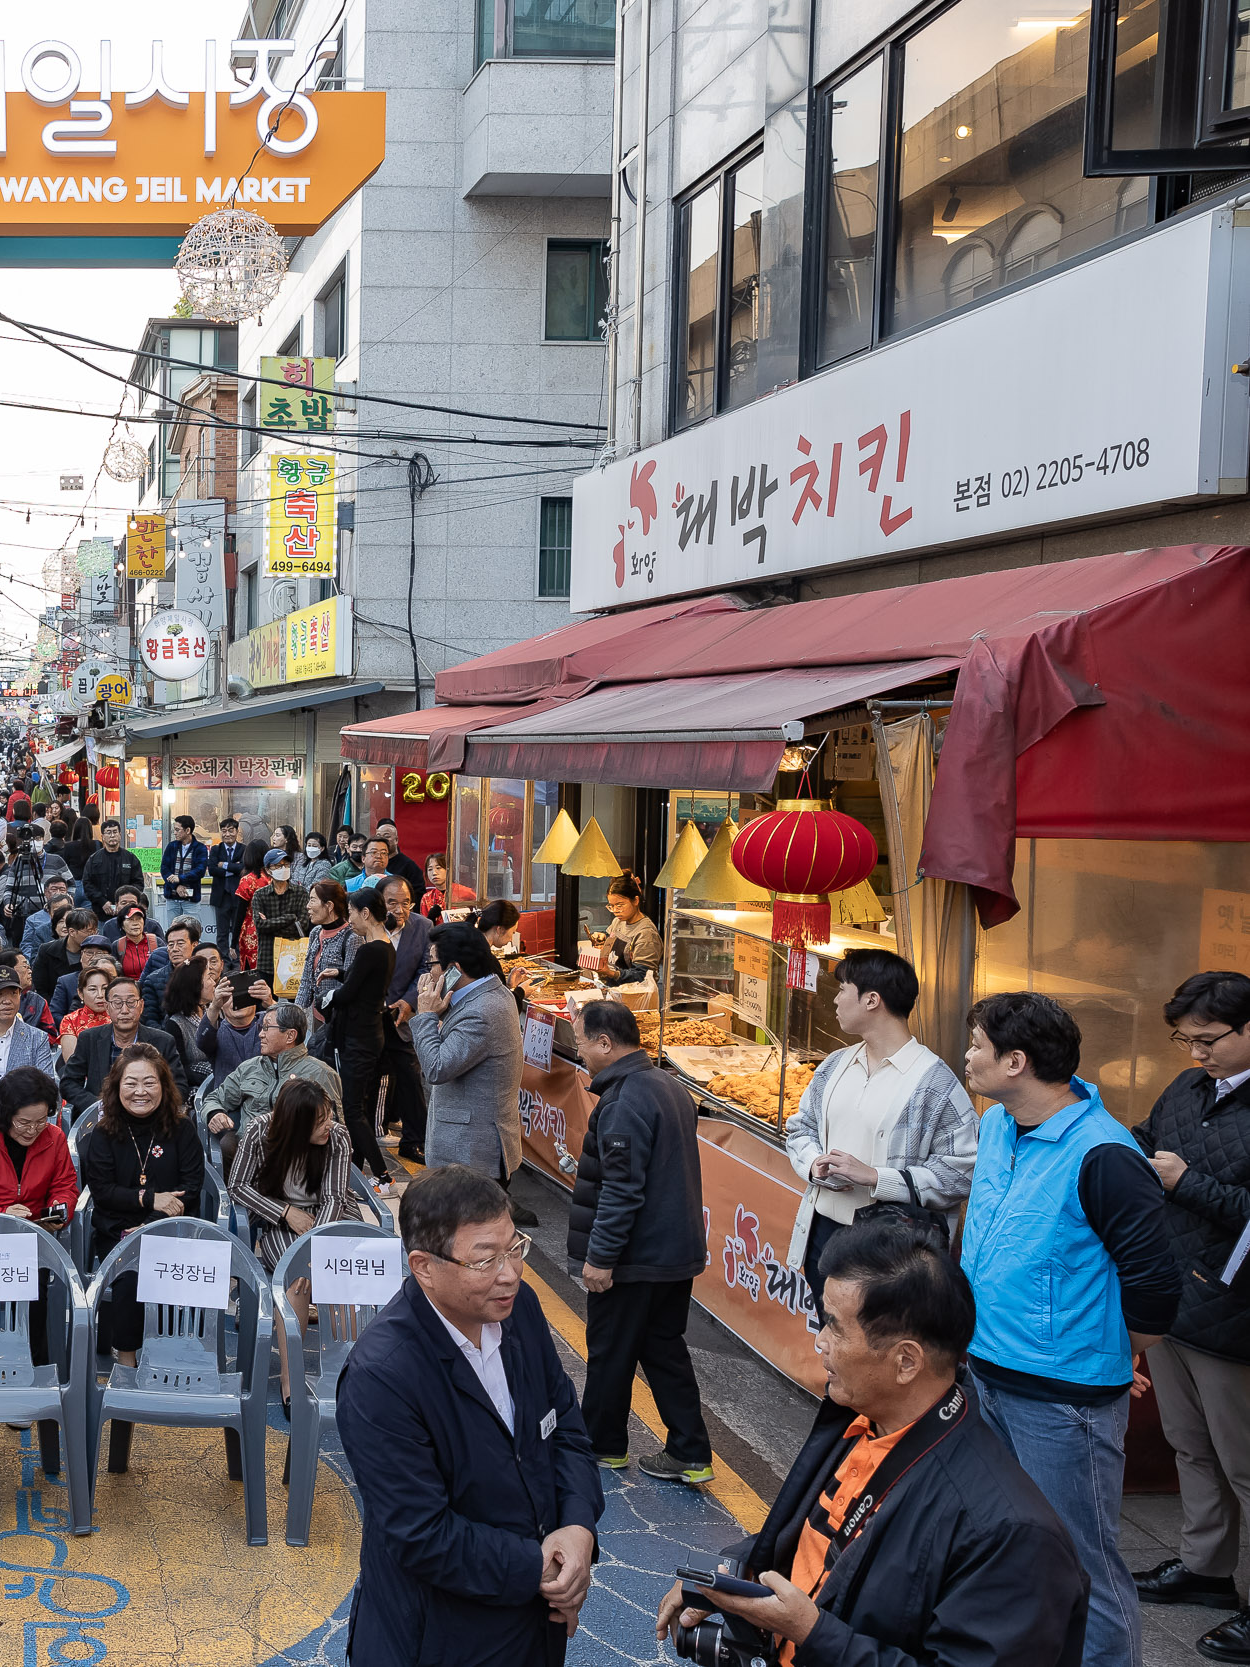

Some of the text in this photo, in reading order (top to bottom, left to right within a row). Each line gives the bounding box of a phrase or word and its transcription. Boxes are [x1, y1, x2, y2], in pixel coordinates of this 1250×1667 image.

[135, 178, 188, 203] JEIL
[195, 177, 311, 203] MARKET
[281, 358, 315, 396] 회
[262, 394, 332, 431] 초밥
[277, 457, 331, 485] 황금
[953, 436, 1151, 513] 본점 02) 2205-4708
[271, 560, 331, 573] 499-6494
[631, 549, 657, 584] 화양
[146, 636, 206, 661] 황금축산
[291, 611, 330, 660] 황금축산
[97, 682, 128, 699] 광어
[176, 757, 303, 778] 소·돼지 막창판매
[154, 1262, 216, 1283] 구청장님
[324, 1259, 385, 1276] 시의원님
[739, 1265, 759, 1298] 화양
[843, 1494, 873, 1537] Canon
